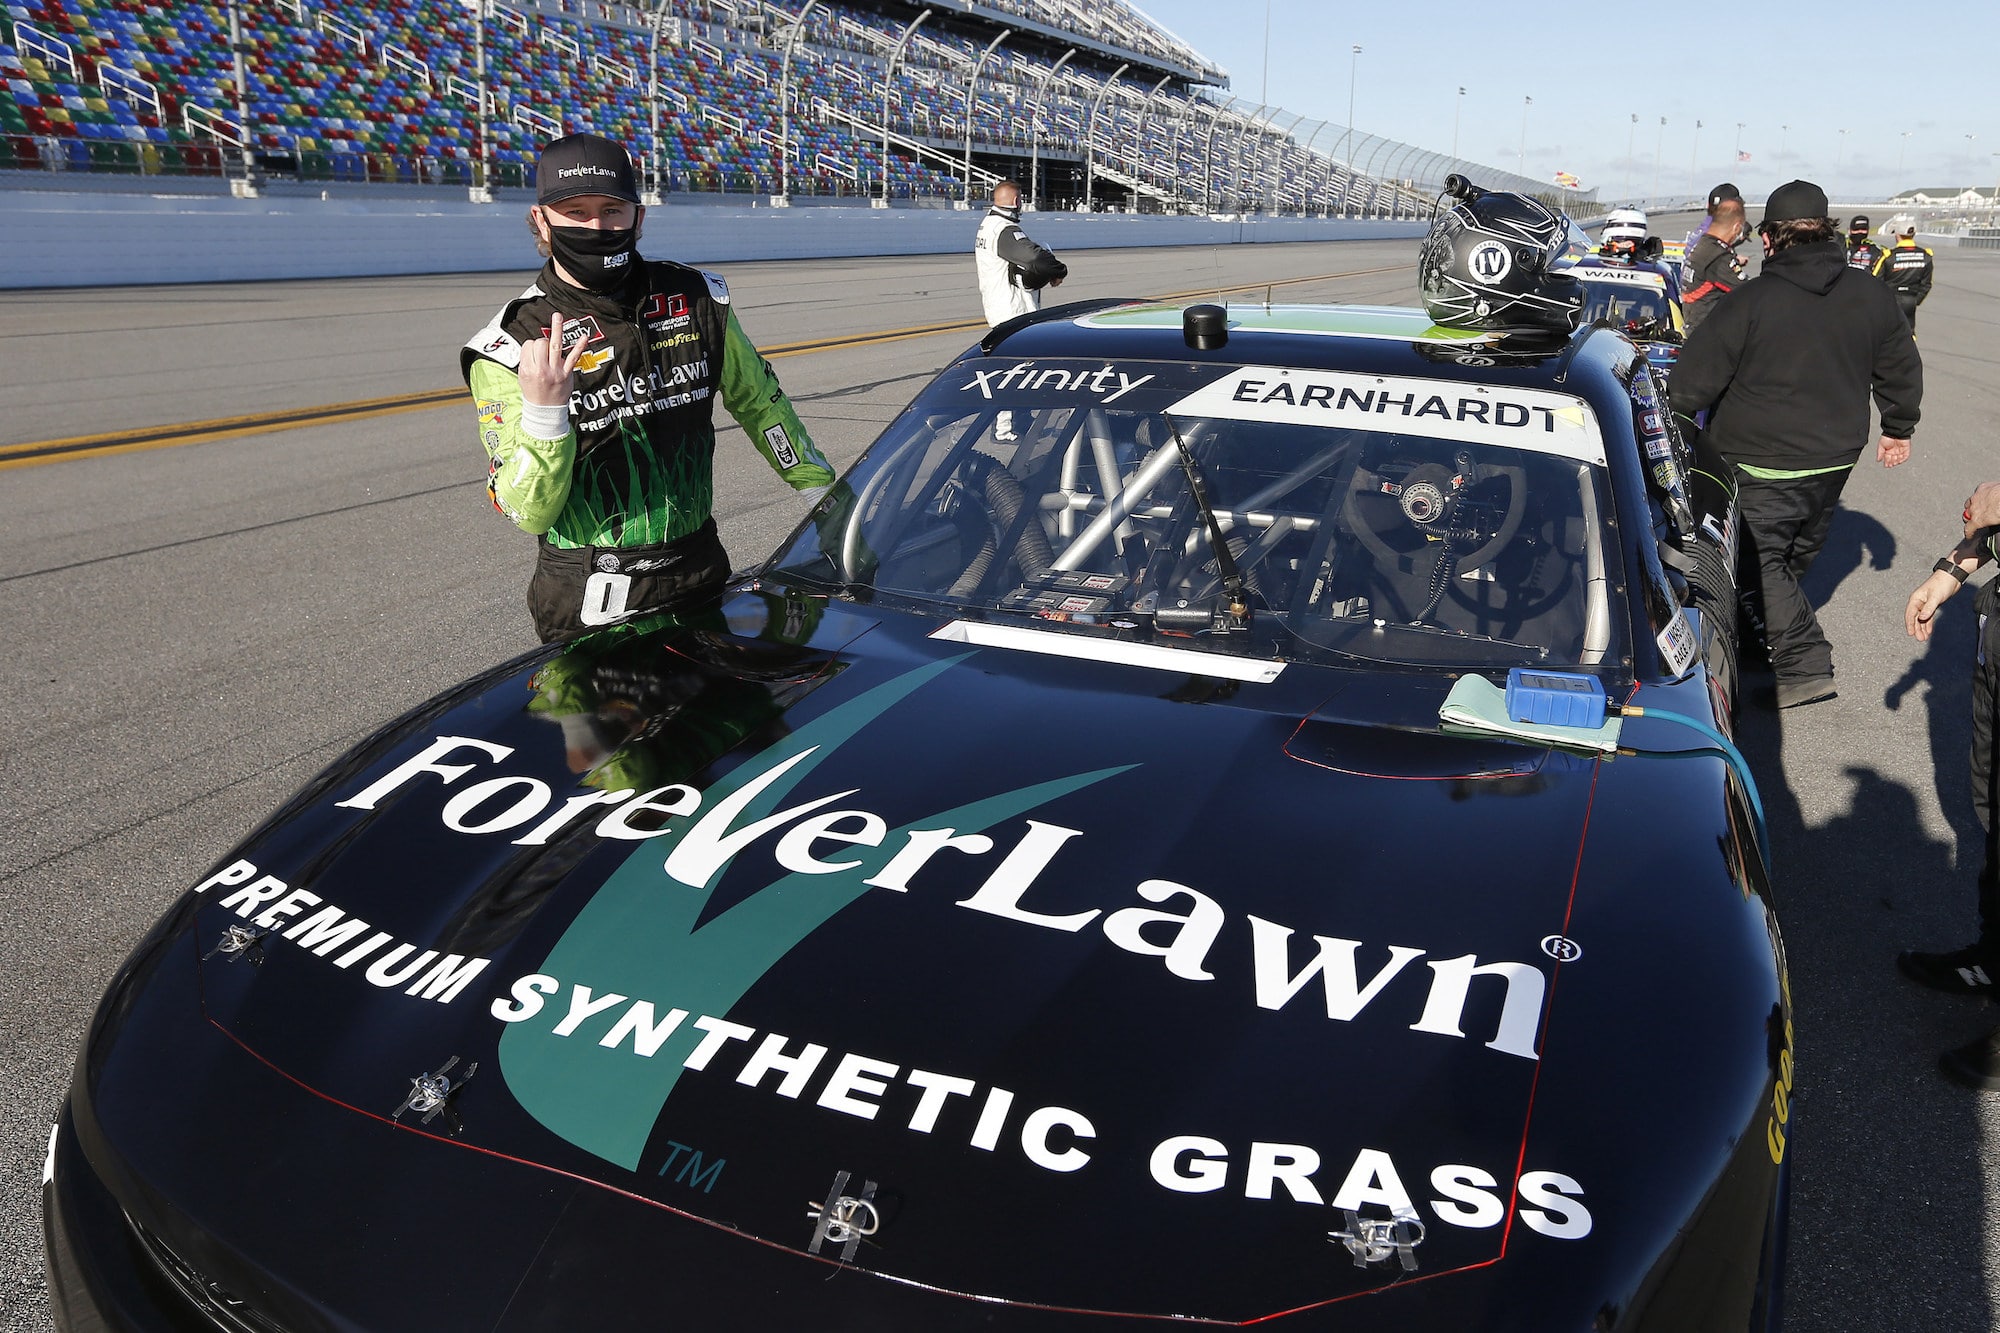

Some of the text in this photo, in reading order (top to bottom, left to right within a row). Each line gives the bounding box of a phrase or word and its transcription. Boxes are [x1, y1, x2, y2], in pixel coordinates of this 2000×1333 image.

[1585, 271, 1641, 280] WARE
[648, 315, 691, 329] MOTORSPORTS
[650, 332, 701, 351] GOODYEAR
[478, 403, 501, 416] NOCO
[579, 386, 710, 432] PREMIUM SYNTHETIC TURF
[1232, 380, 1556, 432] EARNHARDT
[194, 859, 1592, 1239] PREMIUM SYNTHETIC GRASS
[657, 1140, 727, 1194] TM
